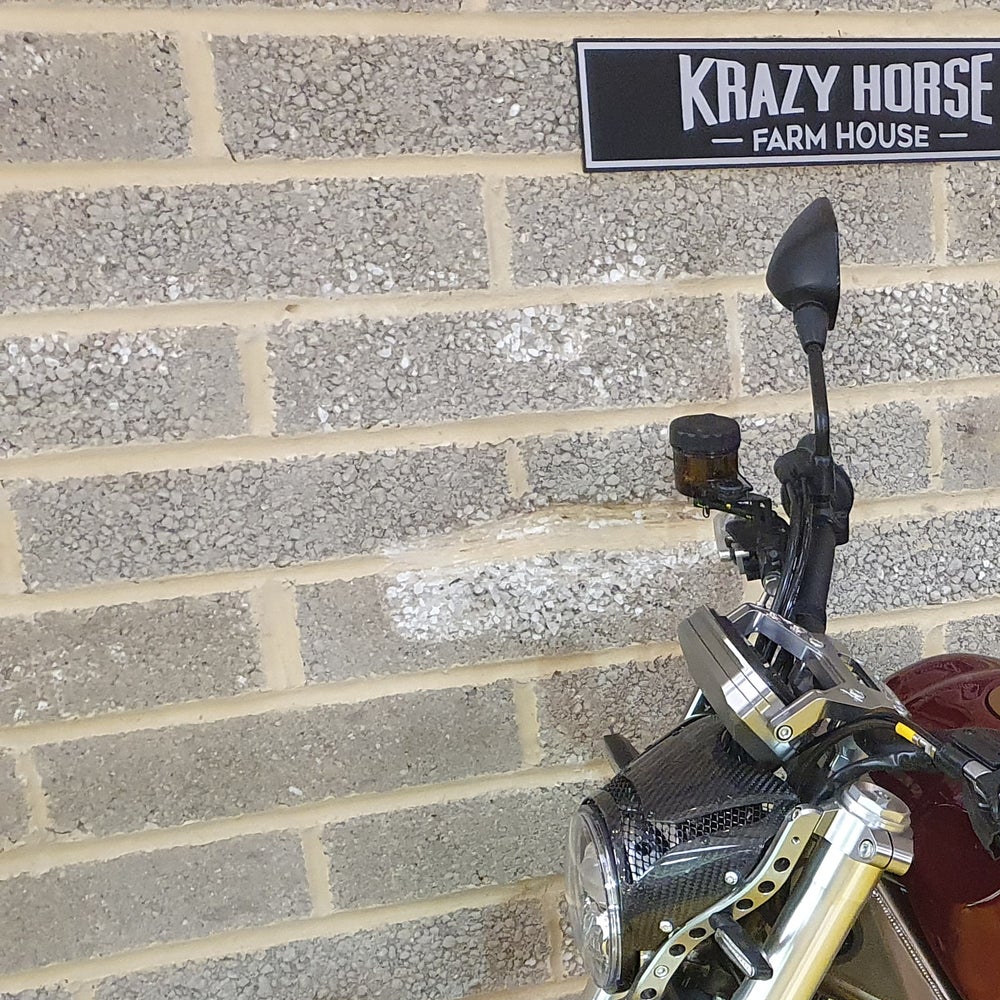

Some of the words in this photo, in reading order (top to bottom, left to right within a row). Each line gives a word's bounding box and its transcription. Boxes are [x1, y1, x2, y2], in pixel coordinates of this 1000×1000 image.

[678, 53, 840, 131] KRAZY
[853, 52, 993, 125] HORSE
[752, 124, 826, 152] FARM
[836, 121, 929, 150] HOUSE
